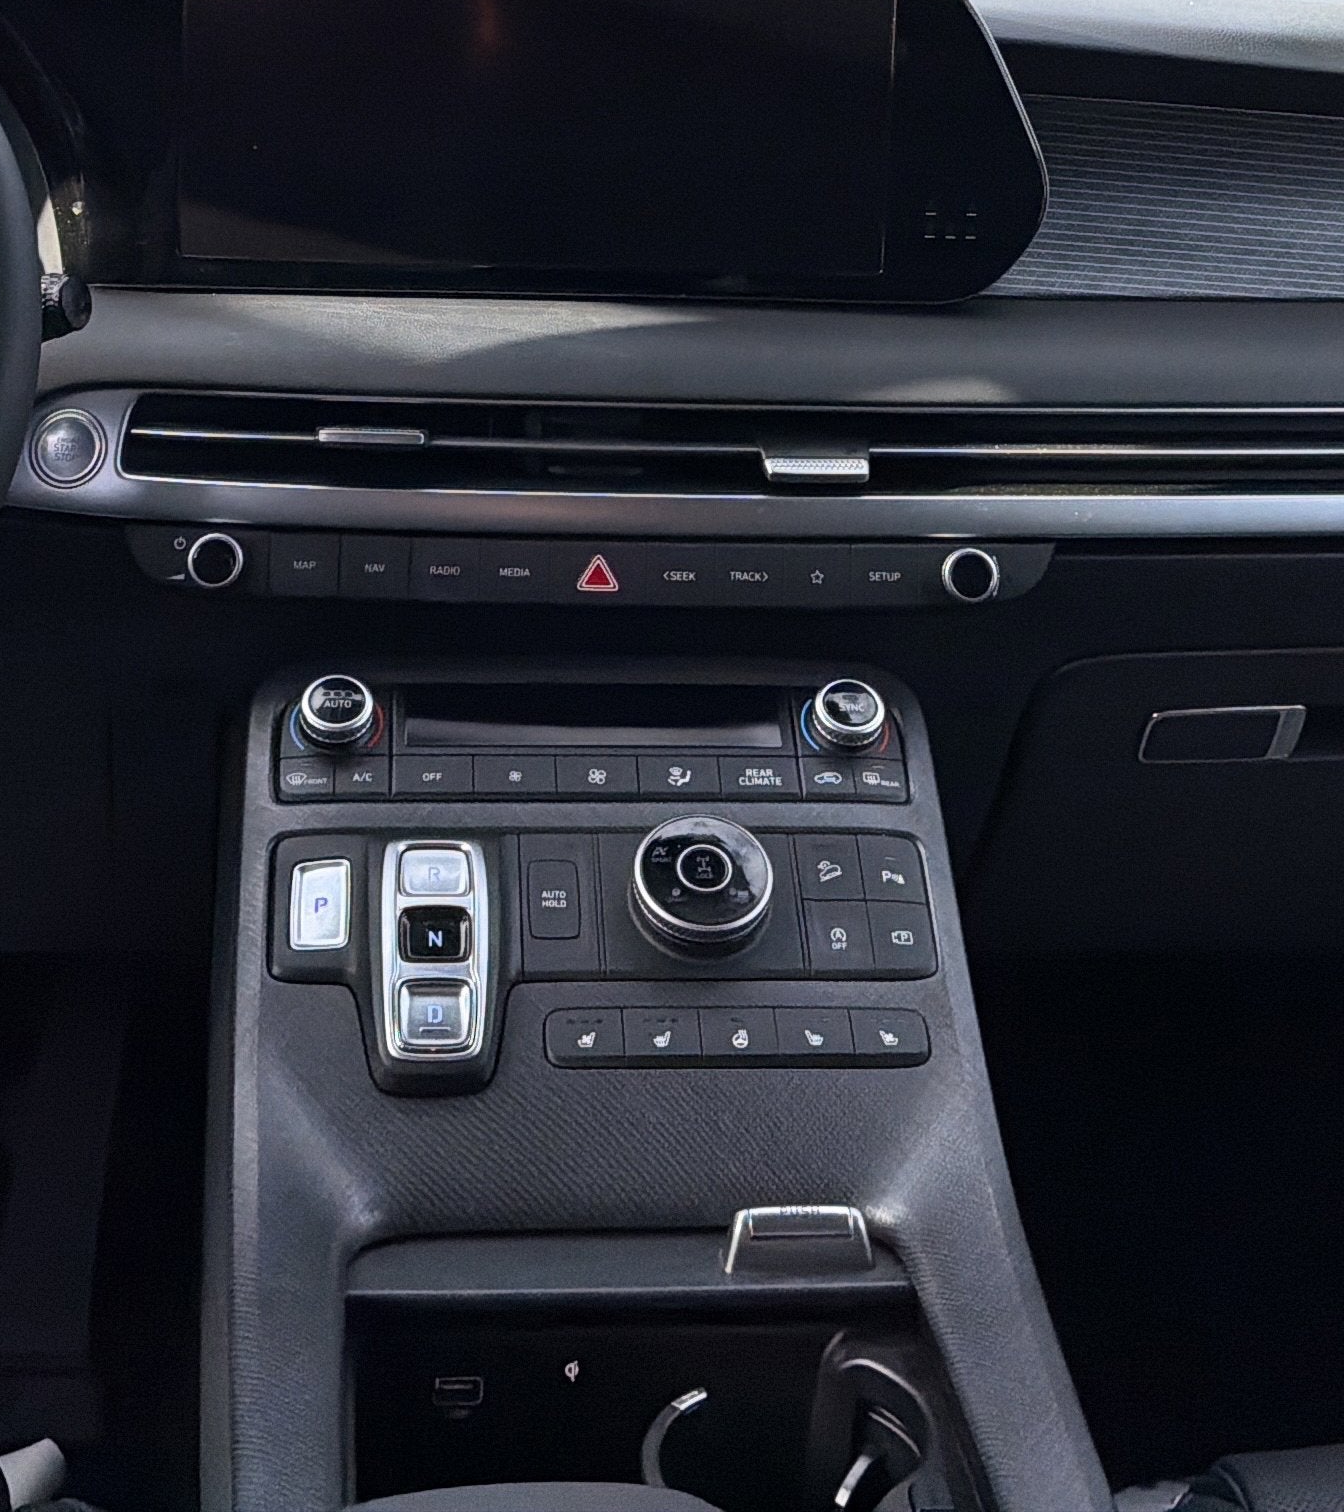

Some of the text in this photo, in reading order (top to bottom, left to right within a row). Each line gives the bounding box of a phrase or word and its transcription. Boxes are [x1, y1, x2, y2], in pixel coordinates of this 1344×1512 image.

[293, 560, 317, 570] MAP
[364, 563, 385, 574] NAV
[429, 565, 461, 576] RADIO
[498, 567, 531, 578] MEDIA
[868, 571, 902, 583] SETUP
[323, 699, 353, 709] AUTO
[839, 702, 865, 712] SYNC
[352, 771, 373, 783] A/C
[422, 771, 443, 782] OFF
[745, 768, 774, 777] REAR
[303, 777, 328, 785] FRONT
[738, 776, 783, 787] CLIMATE
[427, 866, 441, 883] R
[541, 890, 567, 899] AUTO
[314, 897, 329, 914] P
[541, 898, 567, 909] HOLD
[427, 930, 444, 948] N
[830, 941, 847, 950] OFF
[426, 1004, 444, 1025] D
[779, 1205, 821, 1216] PUSH
